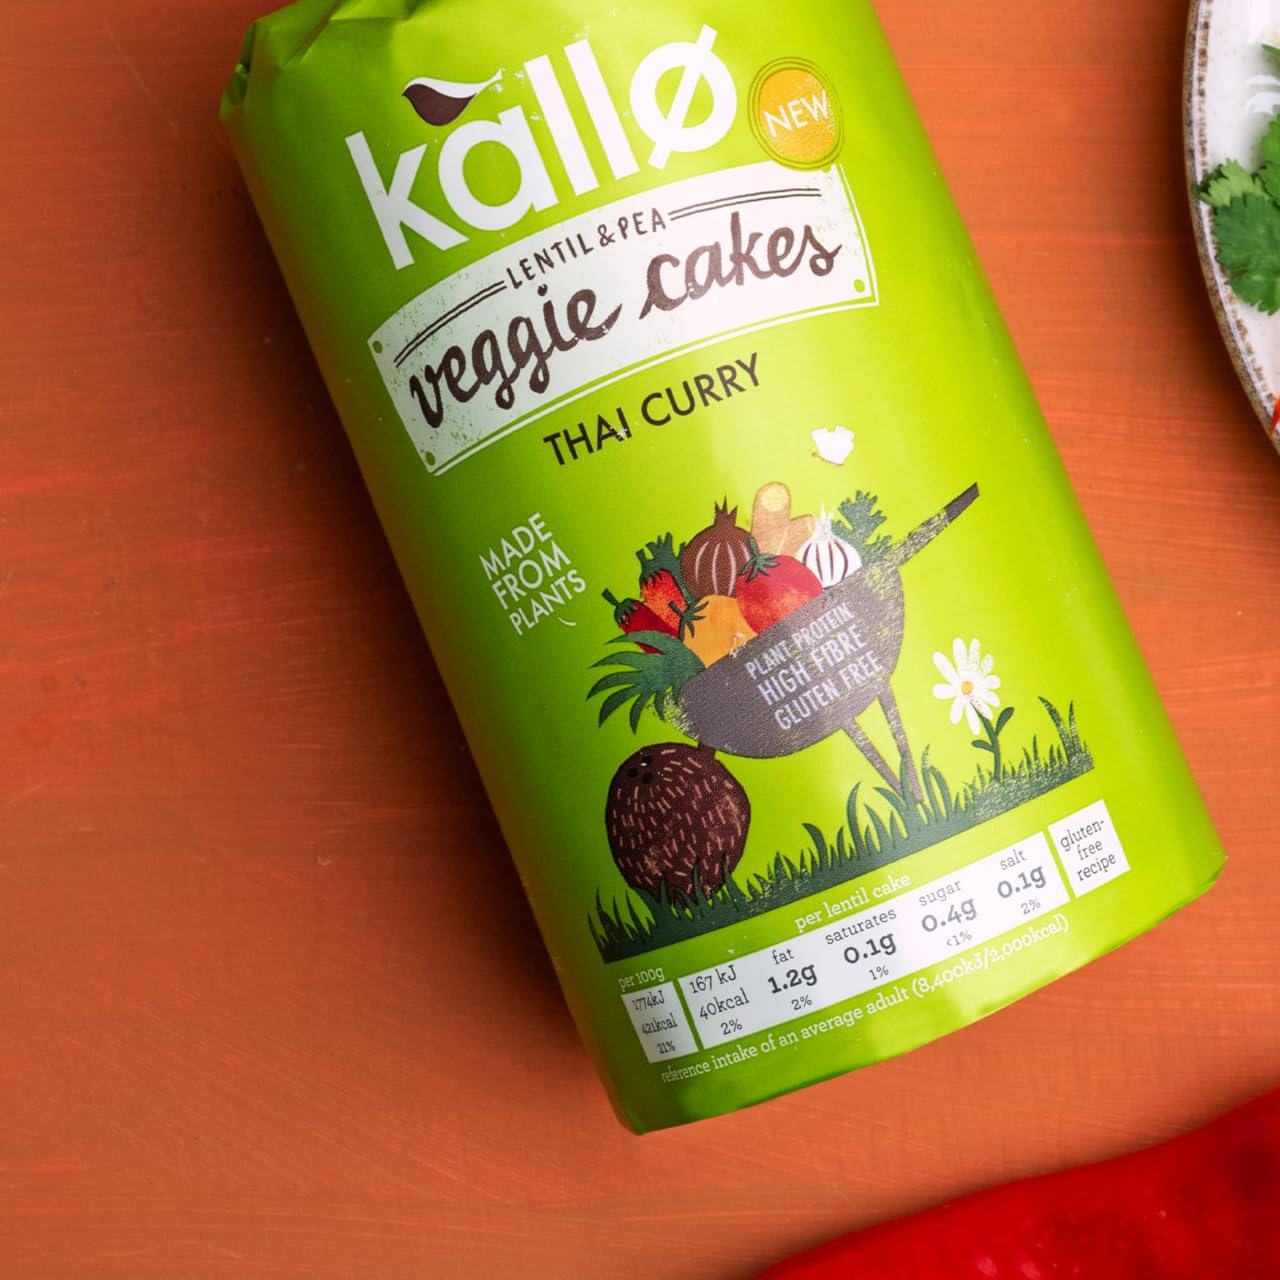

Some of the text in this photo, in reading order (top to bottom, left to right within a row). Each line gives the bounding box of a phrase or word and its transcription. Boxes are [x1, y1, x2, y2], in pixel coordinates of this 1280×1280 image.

[763, 89, 830, 138] NEW
[506, 207, 667, 290] LENTIL & PEA
[409, 210, 842, 429] veggie cakes
[543, 352, 760, 465] THAI CURRY
[479, 512, 553, 581] MADE
[491, 540, 571, 610] FROM
[509, 569, 586, 635] PLANTS
[745, 602, 855, 680] PLANT PROTEIN
[758, 624, 866, 706] HIGH FIBRE
[774, 650, 883, 731] GLUTEN FREE
[1060, 818, 1105, 851] gluten-
[1077, 839, 1103, 861] free
[999, 848, 1027, 871] salt
[1076, 852, 1116, 882] recipe
[918, 880, 962, 907] sugar
[996, 864, 1047, 900] 0.1g
[794, 872, 912, 934] per lentil cake
[921, 897, 978, 932] 0.4g
[1020, 898, 1042, 915] 2%
[825, 908, 897, 945] saturates
[944, 929, 973, 948] <1%
[772, 948, 795, 965] fat
[843, 932, 898, 964] 0.1g
[618, 967, 665, 993] per 100g
[689, 964, 738, 994] 167 kJ
[768, 963, 818, 994] 1.2g
[869, 964, 889, 981] 1%
[699, 987, 750, 1020] 40kcal
[791, 994, 813, 1011] 2%
[641, 1012, 678, 1035] 421kcal
[661, 1061, 711, 1083] reference
[713, 1044, 758, 1069] intake
[760, 1033, 775, 1053] of
[779, 1031, 799, 1047] an
[801, 1006, 864, 1039] average
[866, 985, 910, 1015] adult
[720, 1018, 744, 1036] 2%
[656, 1040, 676, 1055] 21%
